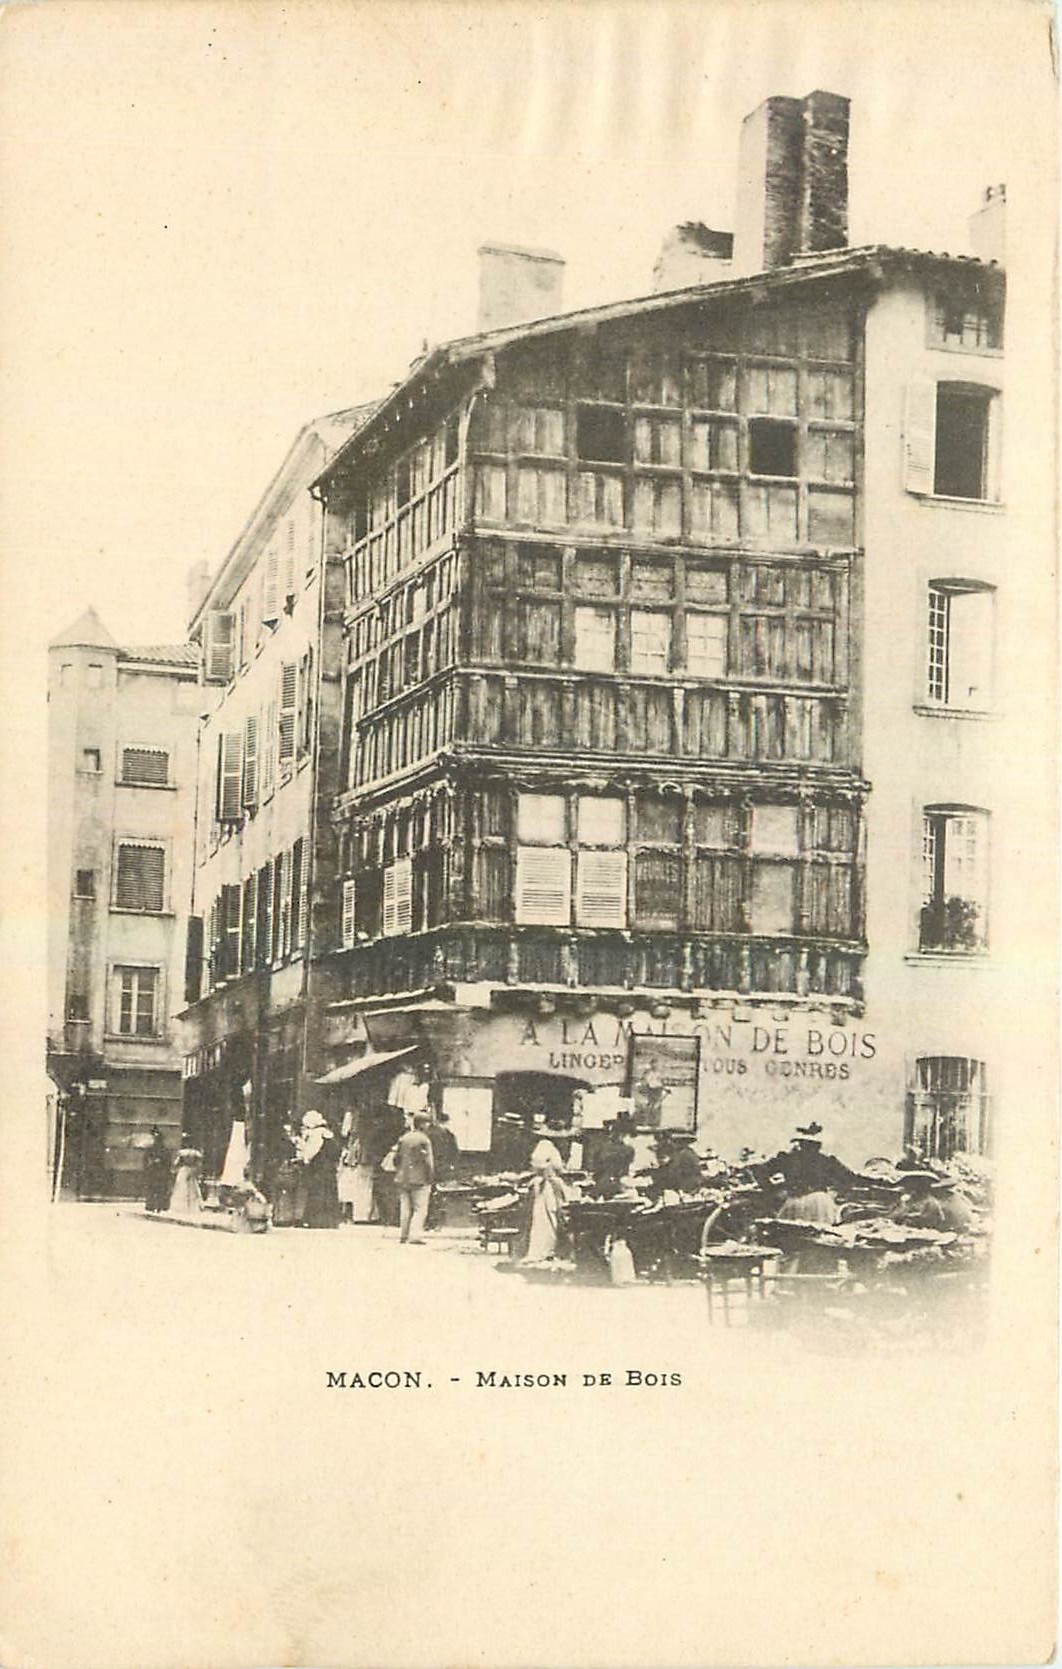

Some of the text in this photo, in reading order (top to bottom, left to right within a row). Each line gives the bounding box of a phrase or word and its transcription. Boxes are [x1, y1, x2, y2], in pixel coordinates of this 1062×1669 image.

[520, 1020, 540, 1046] A
[561, 1019, 598, 1046] LA
[752, 1026, 789, 1054] DE
[807, 1029, 876, 1059] BOIS
[765, 1060, 850, 1080] GENRES
